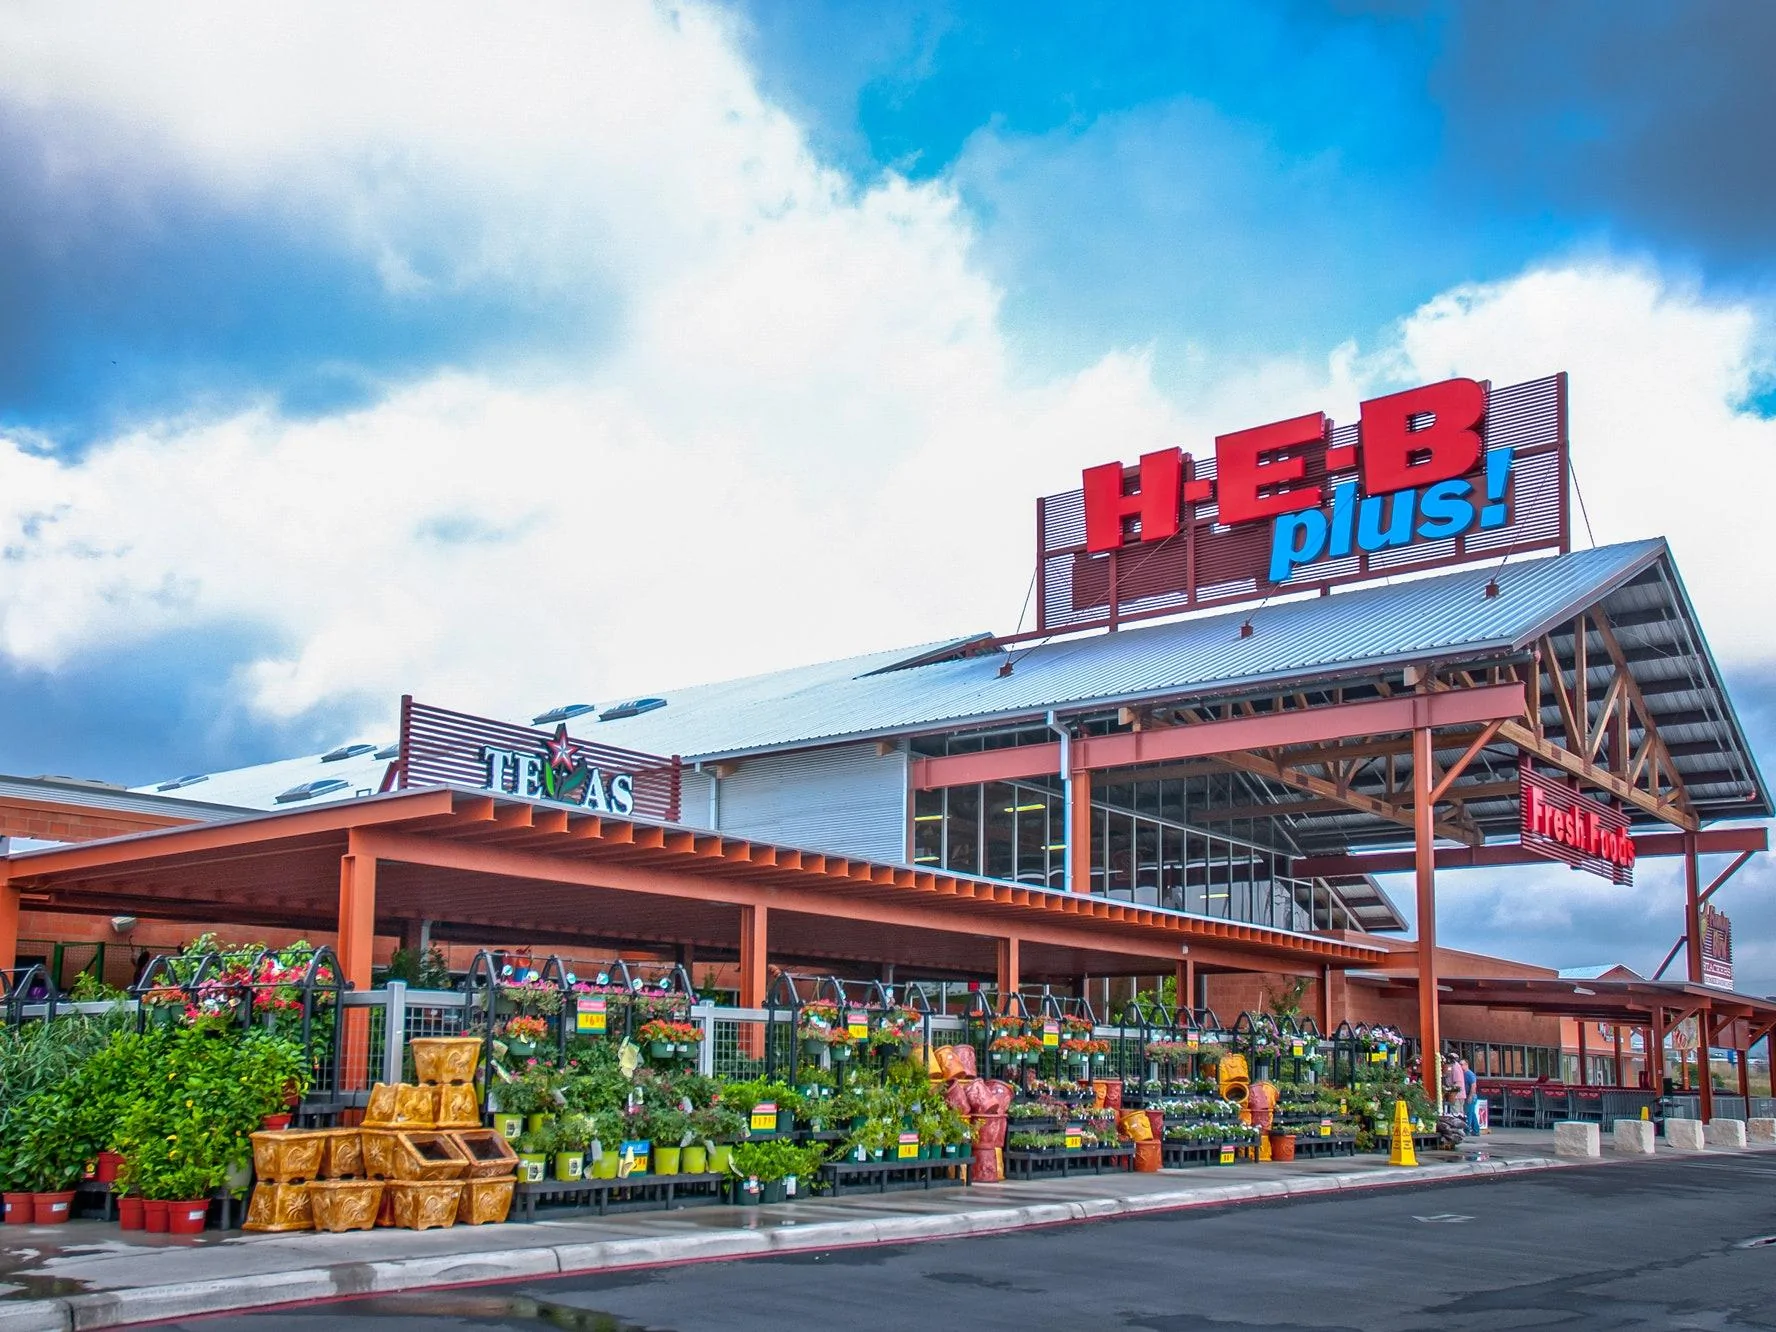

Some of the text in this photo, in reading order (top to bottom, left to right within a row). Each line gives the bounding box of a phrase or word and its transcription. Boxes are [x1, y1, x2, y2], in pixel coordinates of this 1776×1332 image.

[1269, 447, 1515, 582] plus!
[1527, 786, 1636, 869] Fresh Foods
